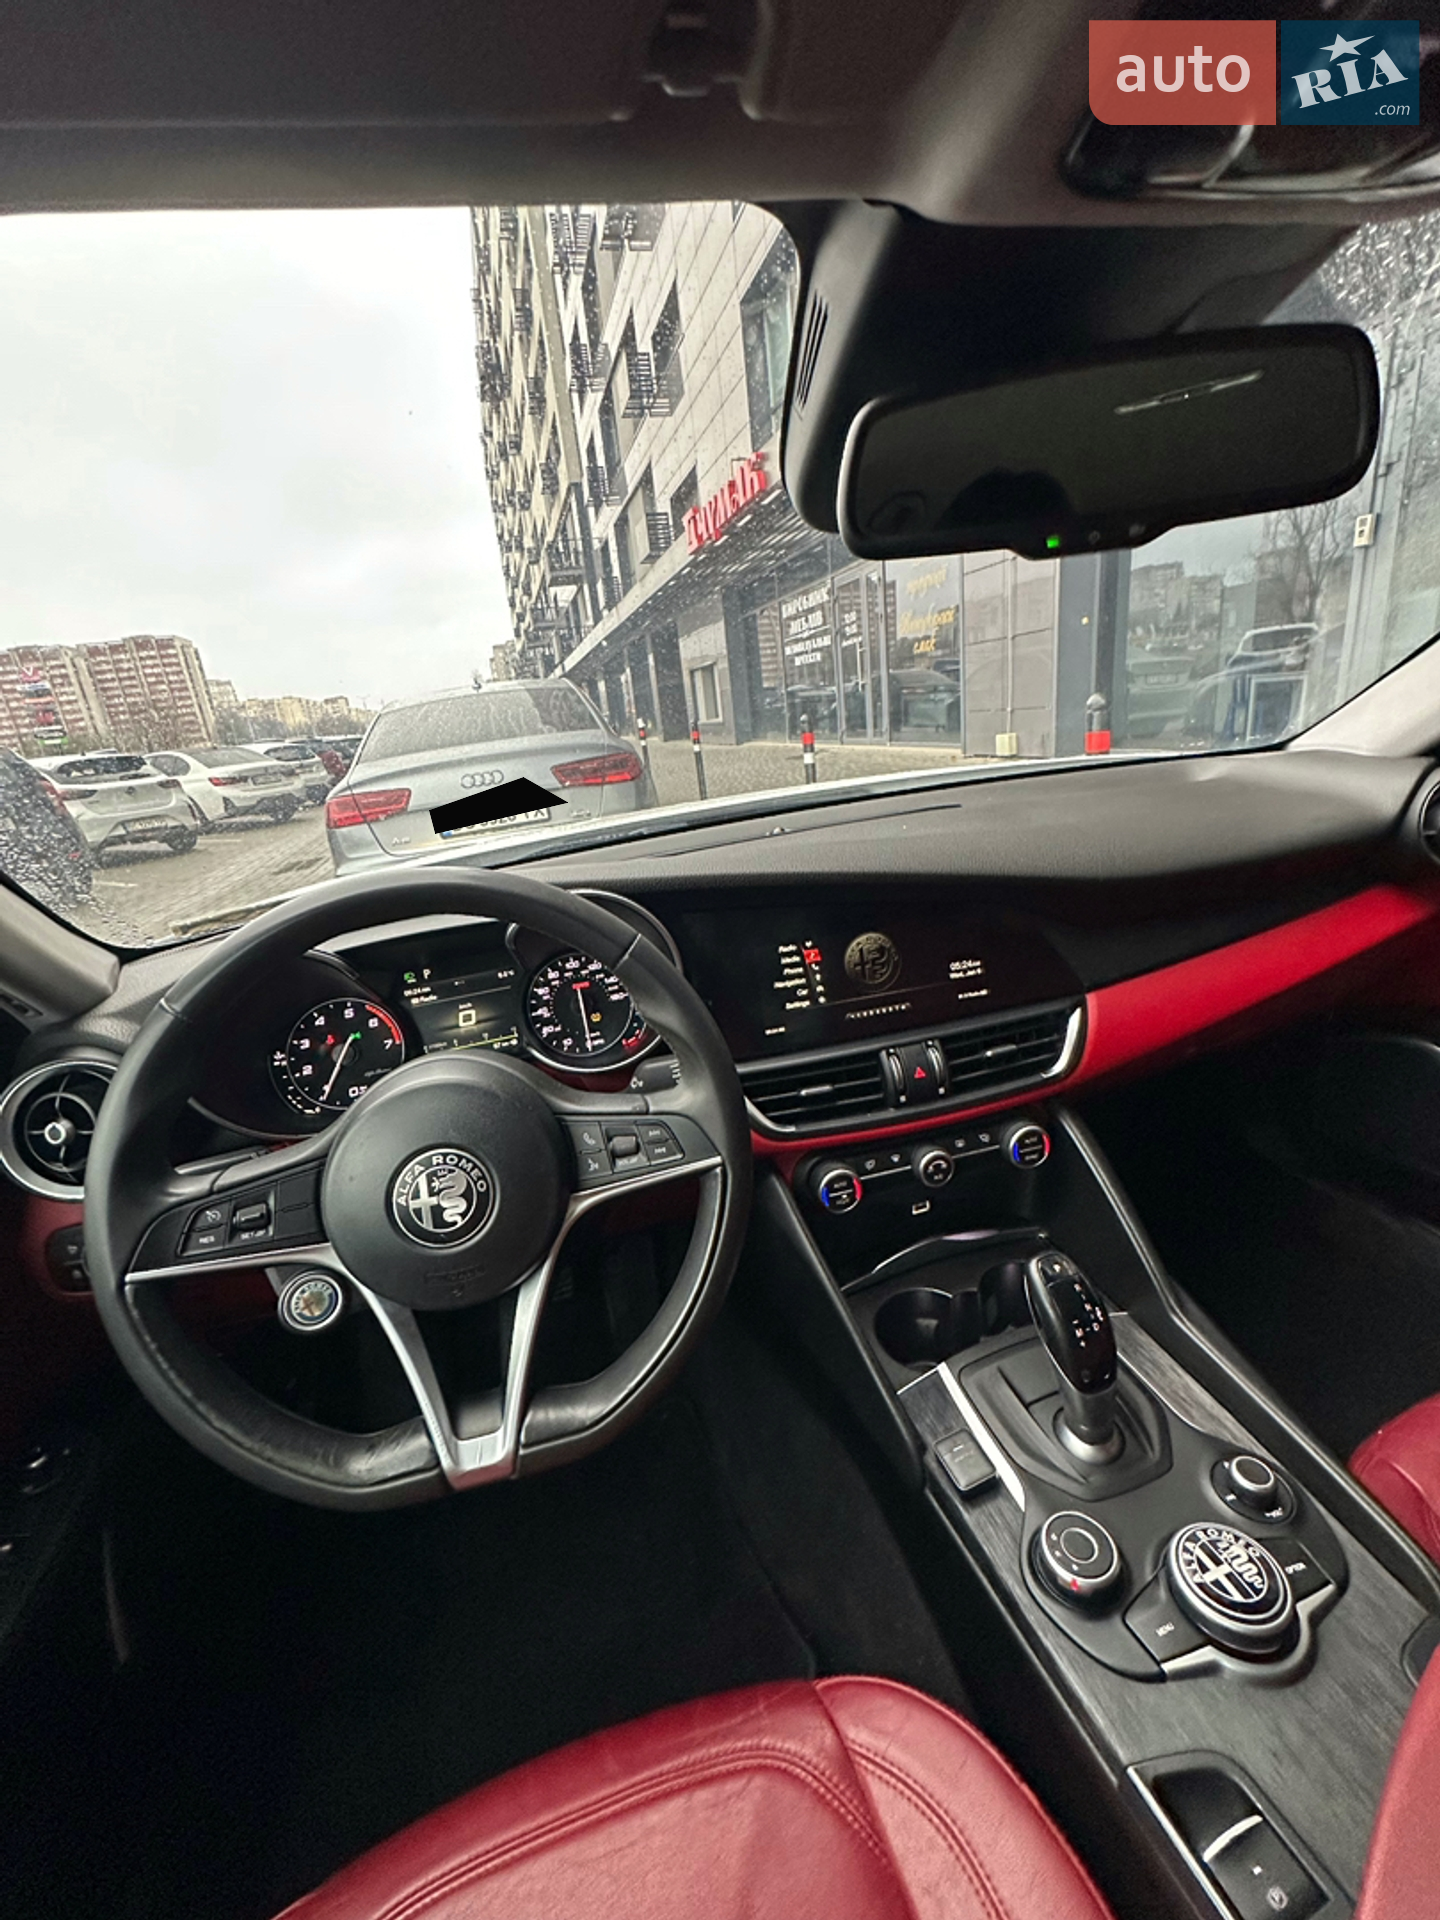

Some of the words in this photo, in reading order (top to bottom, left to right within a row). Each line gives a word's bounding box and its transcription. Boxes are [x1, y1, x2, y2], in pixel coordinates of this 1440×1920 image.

[423, 968, 432, 980] P
[343, 1007, 355, 1019] 5
[314, 1015, 325, 1026] 4
[368, 1017, 379, 1029] 6
[300, 1039, 311, 1050] 3
[383, 1039, 393, 1050] 7
[302, 1065, 313, 1076] 2
[396, 1164, 426, 1207] ALFA
[431, 1154, 487, 1193] ROMEO
[1181, 1541, 1206, 1584] ALFA
[1195, 1528, 1261, 1557] ROMEO
